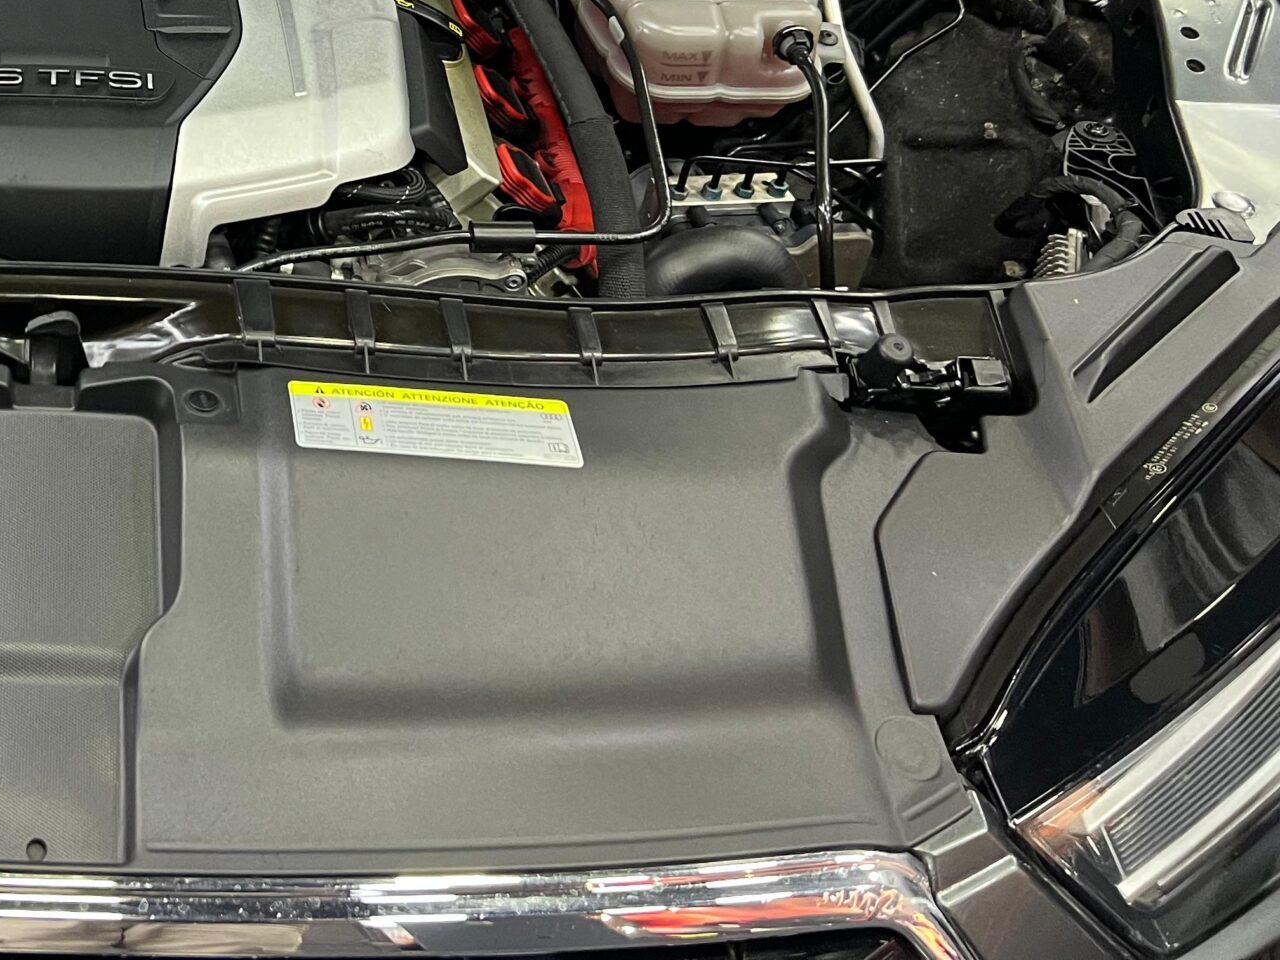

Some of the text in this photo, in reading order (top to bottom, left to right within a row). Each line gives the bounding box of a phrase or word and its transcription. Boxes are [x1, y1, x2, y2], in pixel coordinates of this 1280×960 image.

[662, 50, 698, 61] MAX
[37, 69, 155, 91] TFSI
[660, 72, 693, 82] MIN
[331, 387, 545, 410] ATENCIÓN ATTENZIONE ATENÇÃO
